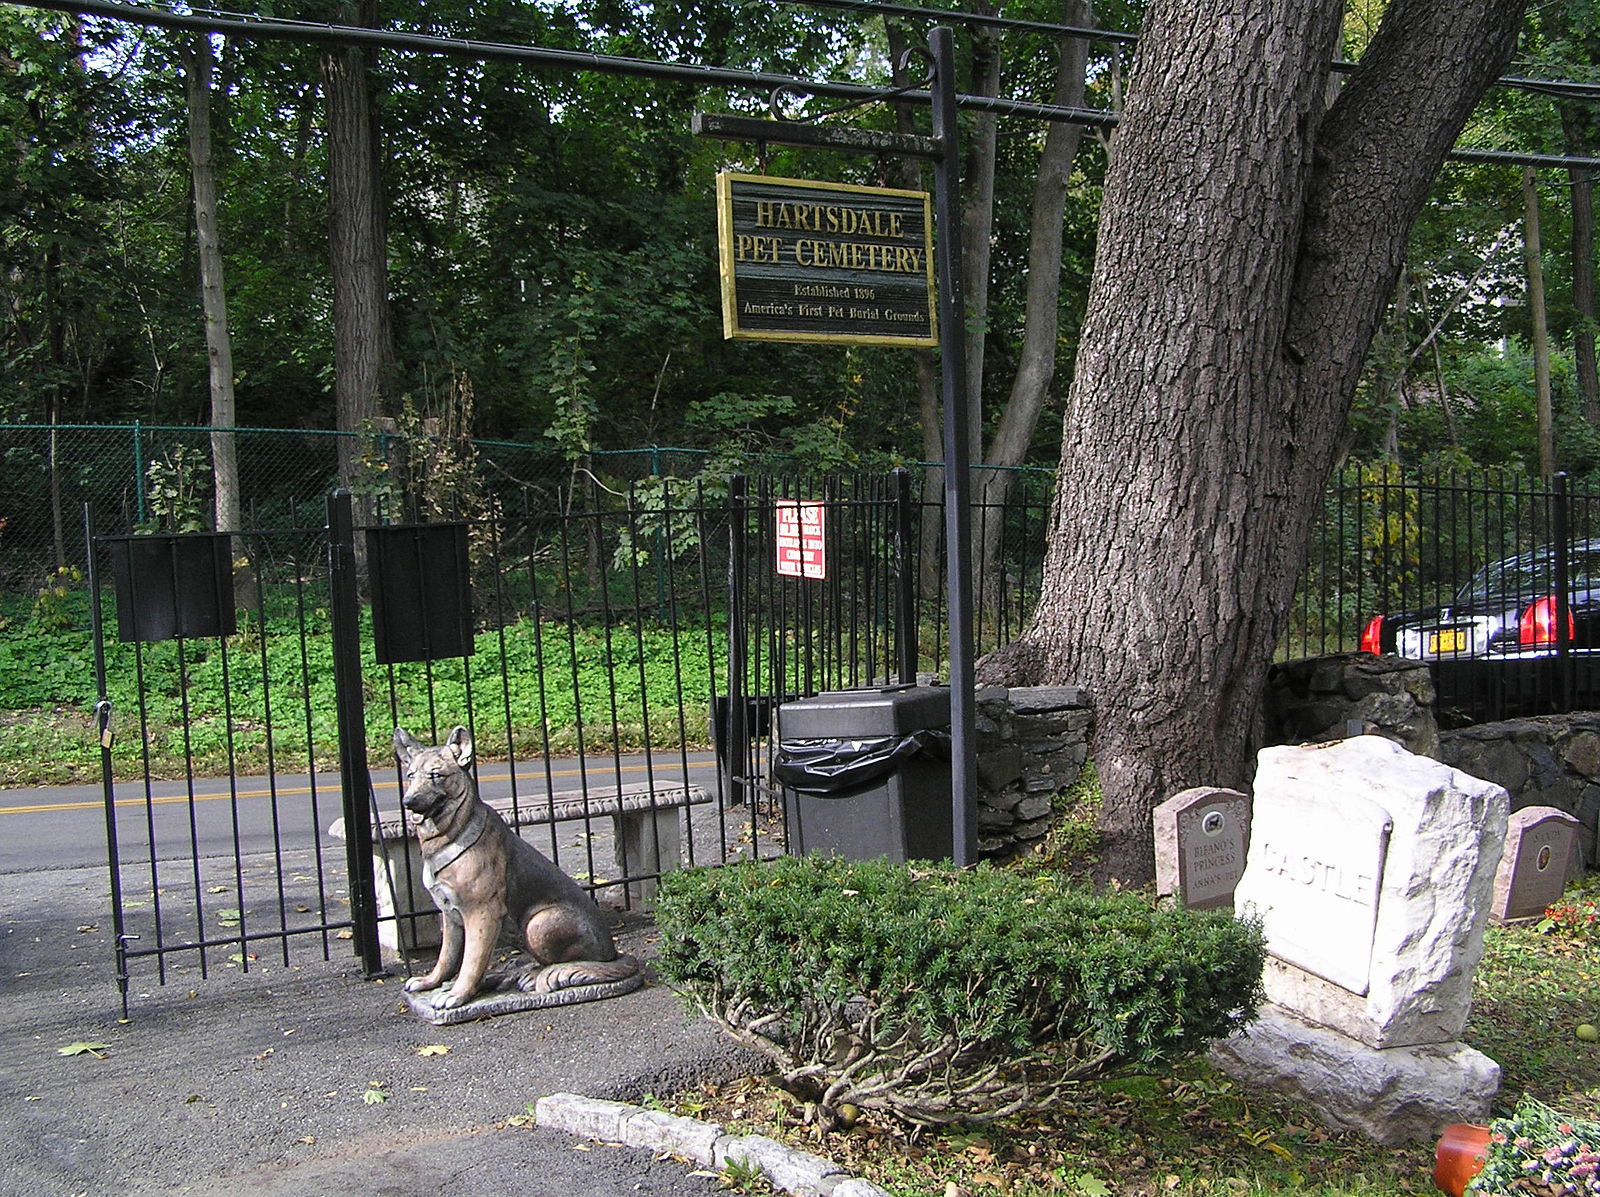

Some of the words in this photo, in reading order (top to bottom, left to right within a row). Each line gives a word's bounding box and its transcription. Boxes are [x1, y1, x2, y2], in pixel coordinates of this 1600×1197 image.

[756, 201, 905, 238] HARTSDALE
[737, 234, 783, 264] PET
[796, 238, 923, 273] CEMETERY
[794, 284, 850, 299] Established
[854, 288, 875, 300] 1896
[744, 302, 793, 316] America's
[800, 305, 823, 318] First
[829, 306, 844, 318] Pet
[850, 307, 879, 321] Burial
[885, 309, 925, 323] Grounds
[1193, 852, 1236, 872] PRINCESS
[1263, 842, 1373, 907] CASTLE
